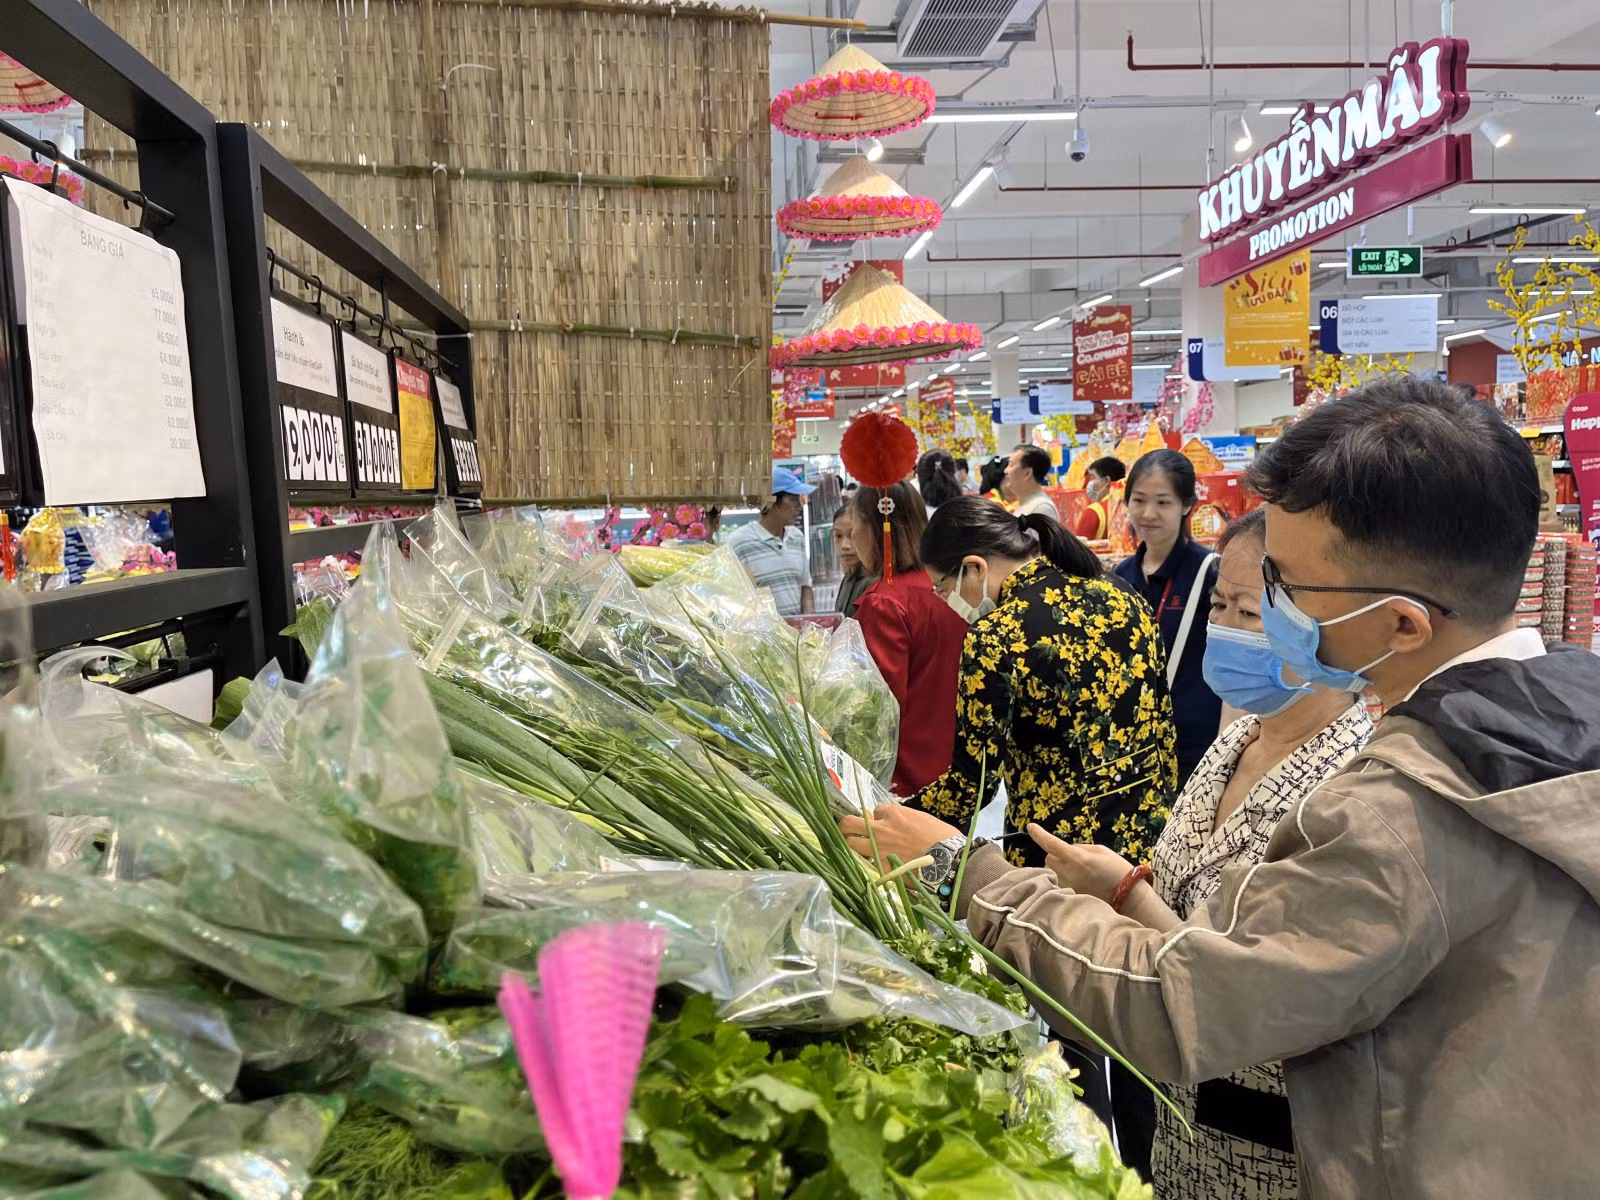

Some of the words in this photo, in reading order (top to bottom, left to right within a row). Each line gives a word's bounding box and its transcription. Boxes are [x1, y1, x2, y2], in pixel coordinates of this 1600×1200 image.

[1199, 108, 1341, 239] KHUYẾN
[1342, 47, 1441, 162] MÃI
[1249, 187, 1355, 260] PROMOTION
[1361, 251, 1380, 261] EXIT
[1321, 306, 1338, 319] 06
[1189, 342, 1202, 354] 07
